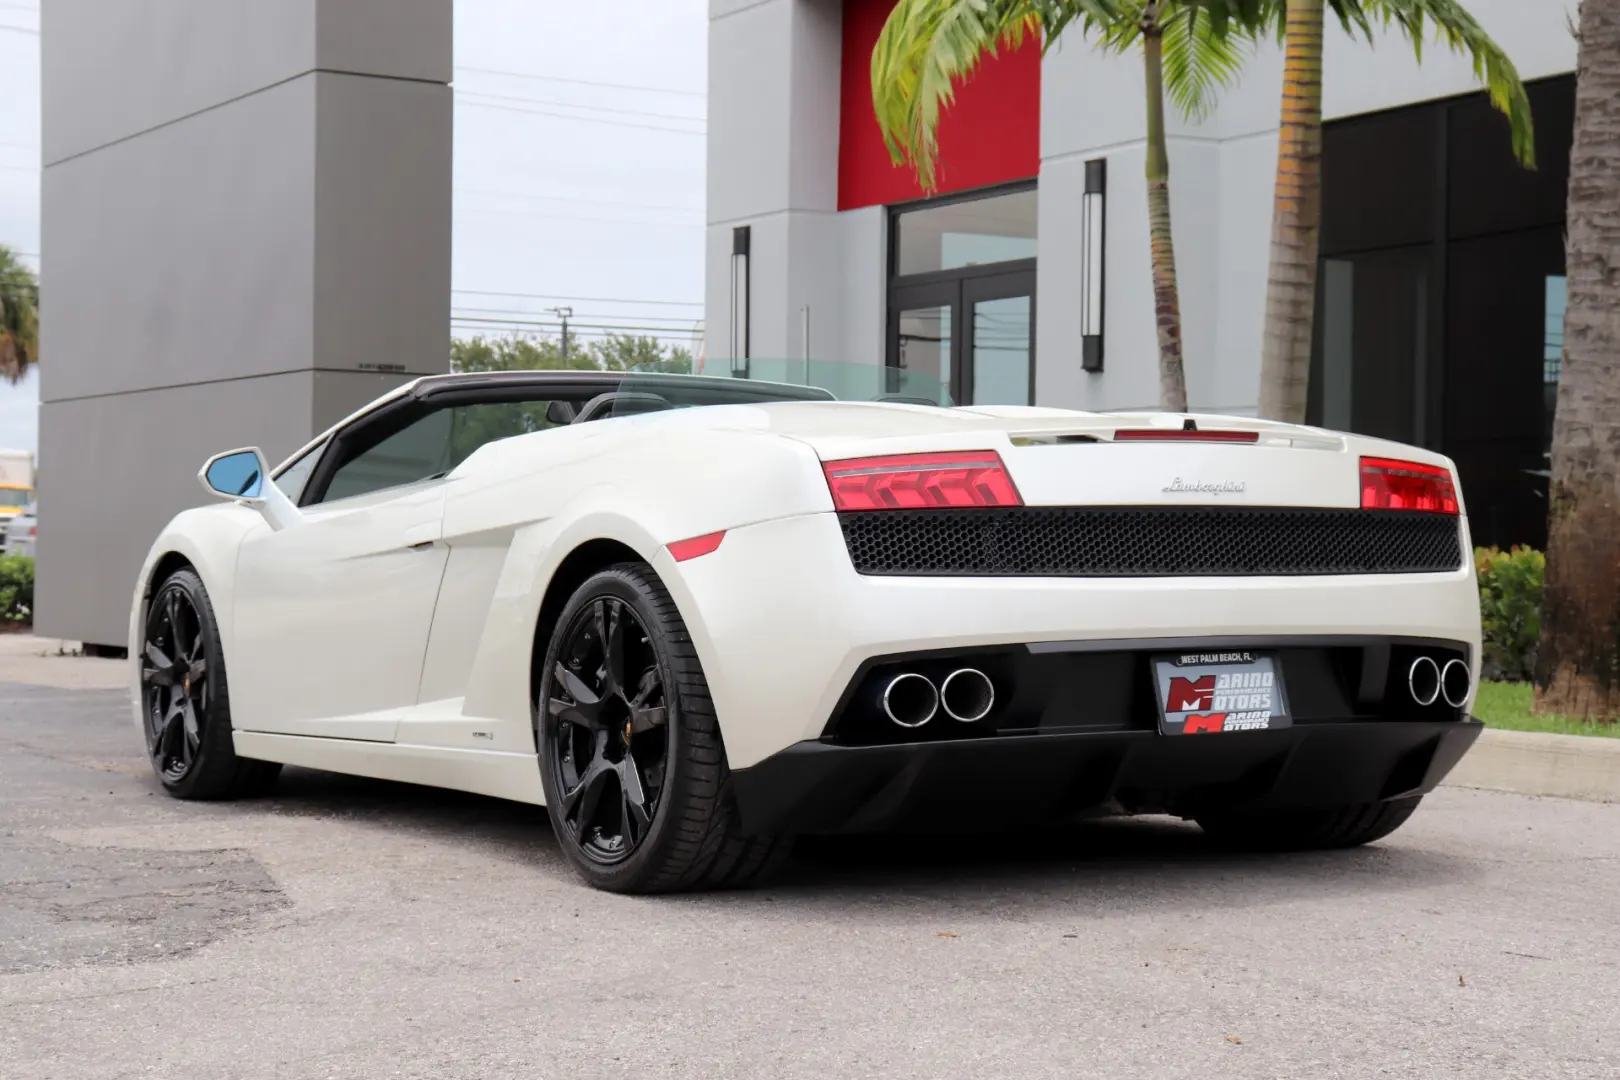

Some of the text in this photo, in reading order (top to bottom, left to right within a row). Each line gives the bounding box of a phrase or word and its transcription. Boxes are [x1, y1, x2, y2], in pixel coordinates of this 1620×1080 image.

[1161, 477, 1246, 496] Lamborghini
[1181, 652, 1252, 664] WEST PALM BEACH, FL
